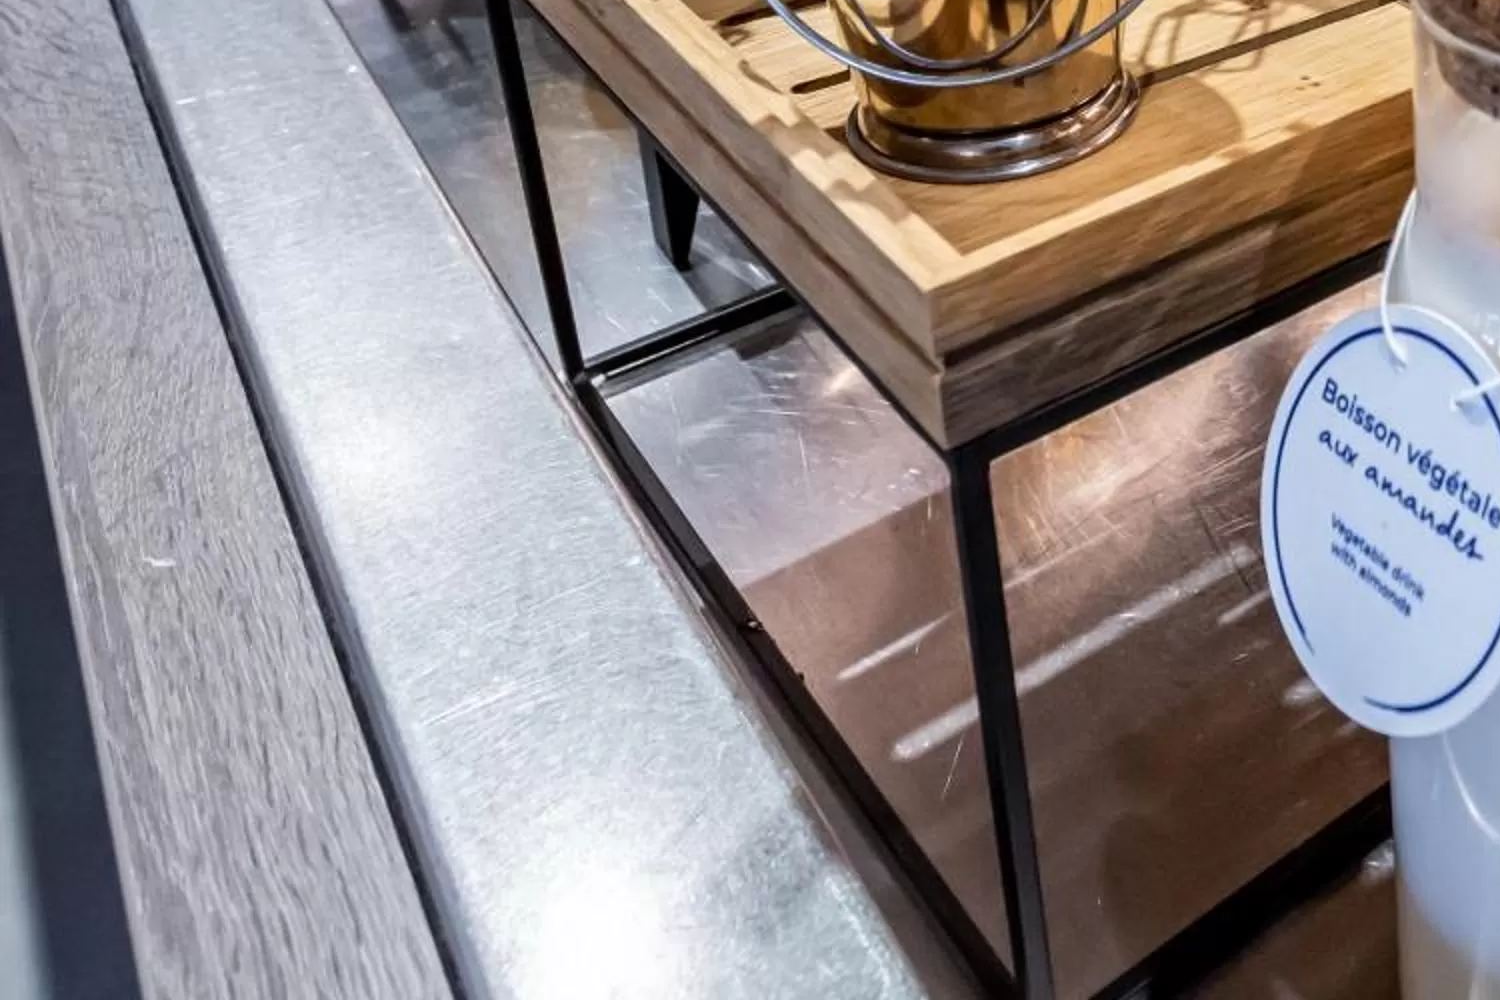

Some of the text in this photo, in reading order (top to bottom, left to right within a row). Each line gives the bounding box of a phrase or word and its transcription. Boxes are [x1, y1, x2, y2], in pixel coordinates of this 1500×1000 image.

[1321, 377, 1401, 455] Boisson
[1318, 429, 1484, 561] aux amandes
[1331, 541, 1411, 617] with almonds
[1391, 566, 1424, 602] drink
